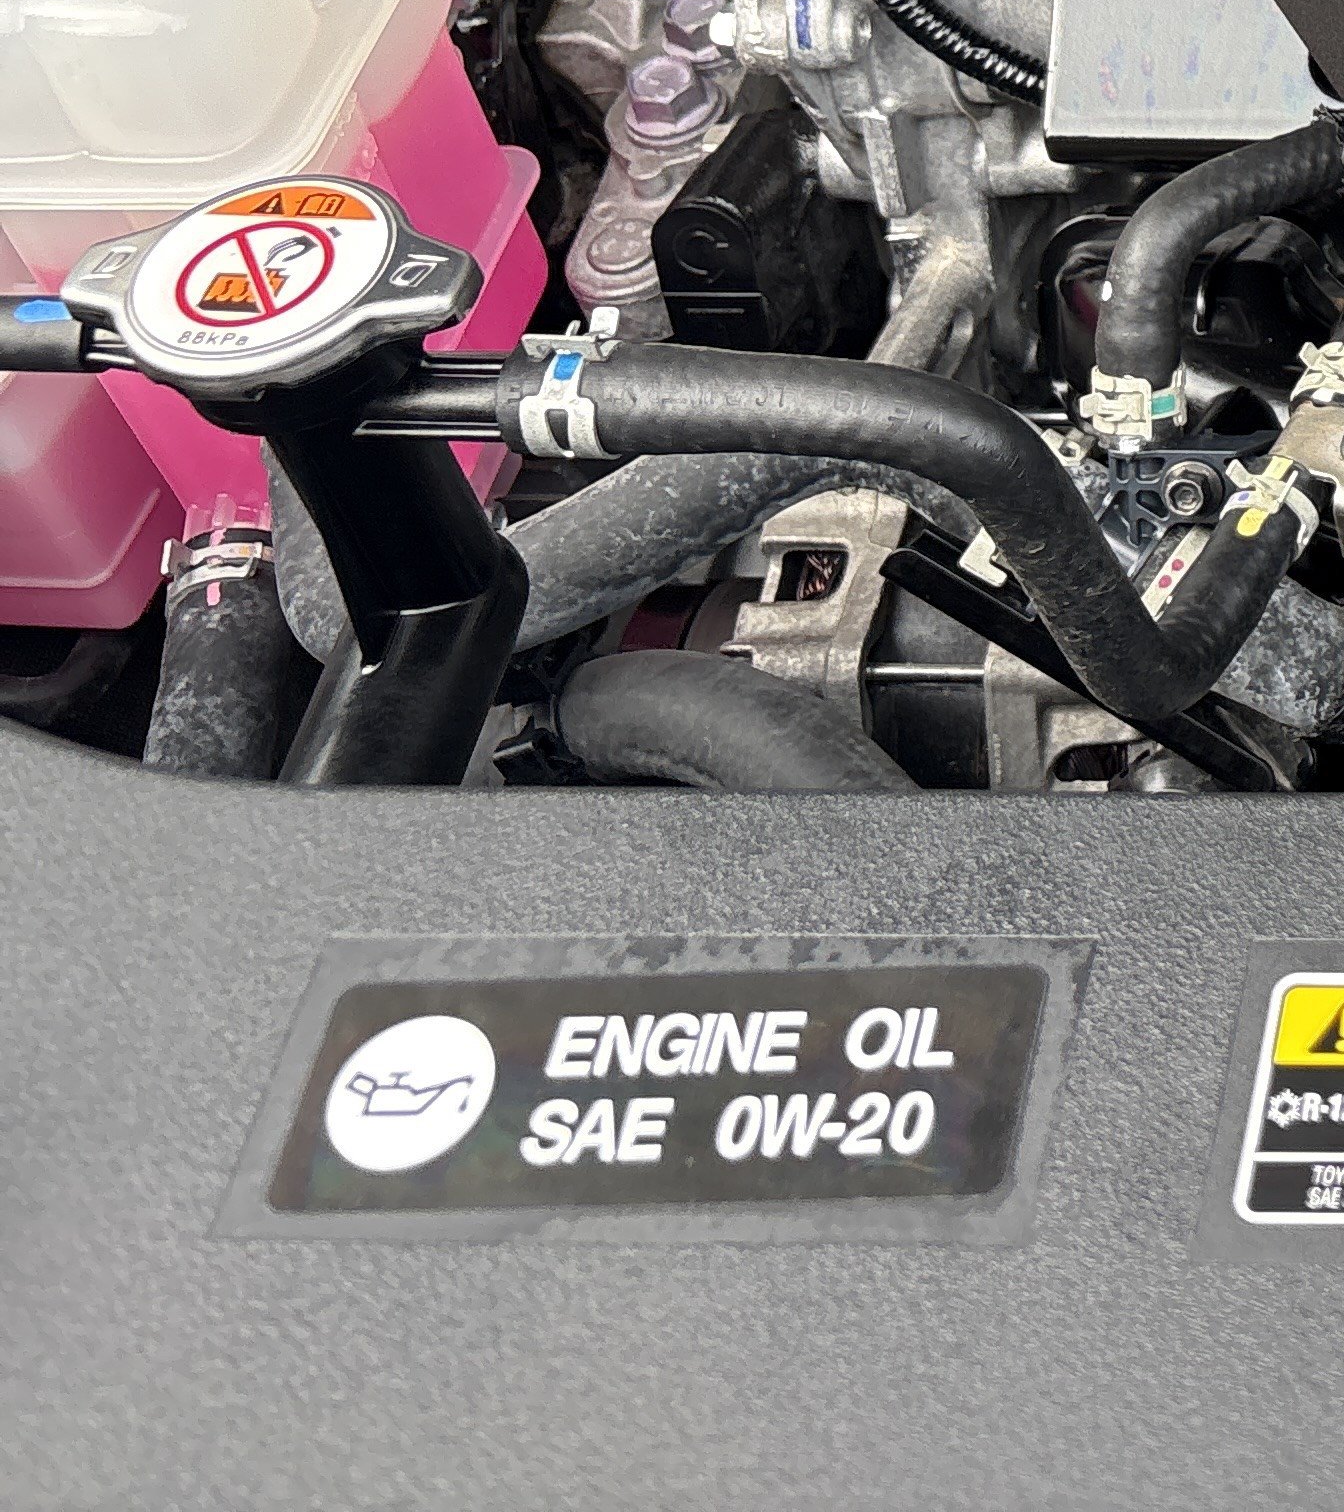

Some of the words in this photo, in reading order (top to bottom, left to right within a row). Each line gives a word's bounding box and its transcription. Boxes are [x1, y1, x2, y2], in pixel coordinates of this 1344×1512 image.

[177, 329, 250, 347] 88kPa
[544, 1009, 808, 1079] ENGINE
[844, 1006, 955, 1072] OIL
[519, 1096, 675, 1167] SAE
[715, 1089, 936, 1162] 0W-20
[1306, 1186, 1342, 1209] SAE
